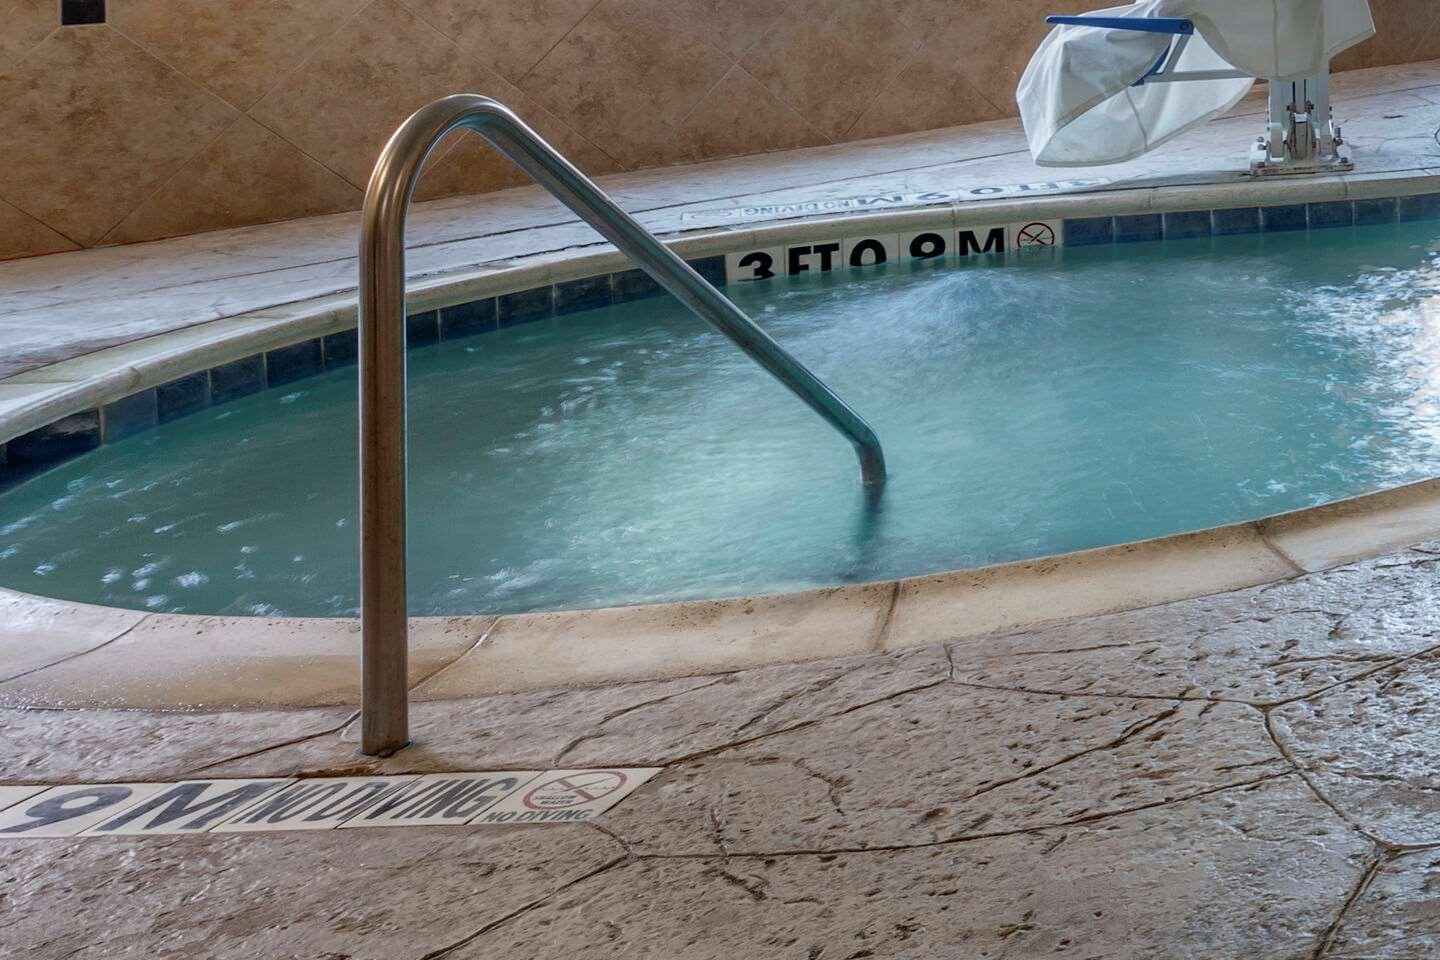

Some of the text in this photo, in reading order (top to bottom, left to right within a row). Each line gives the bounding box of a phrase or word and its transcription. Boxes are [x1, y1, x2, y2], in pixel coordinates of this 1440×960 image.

[0, 777, 519, 834] 9 M NO DIVING
[481, 809, 594, 823] NO DIVING
